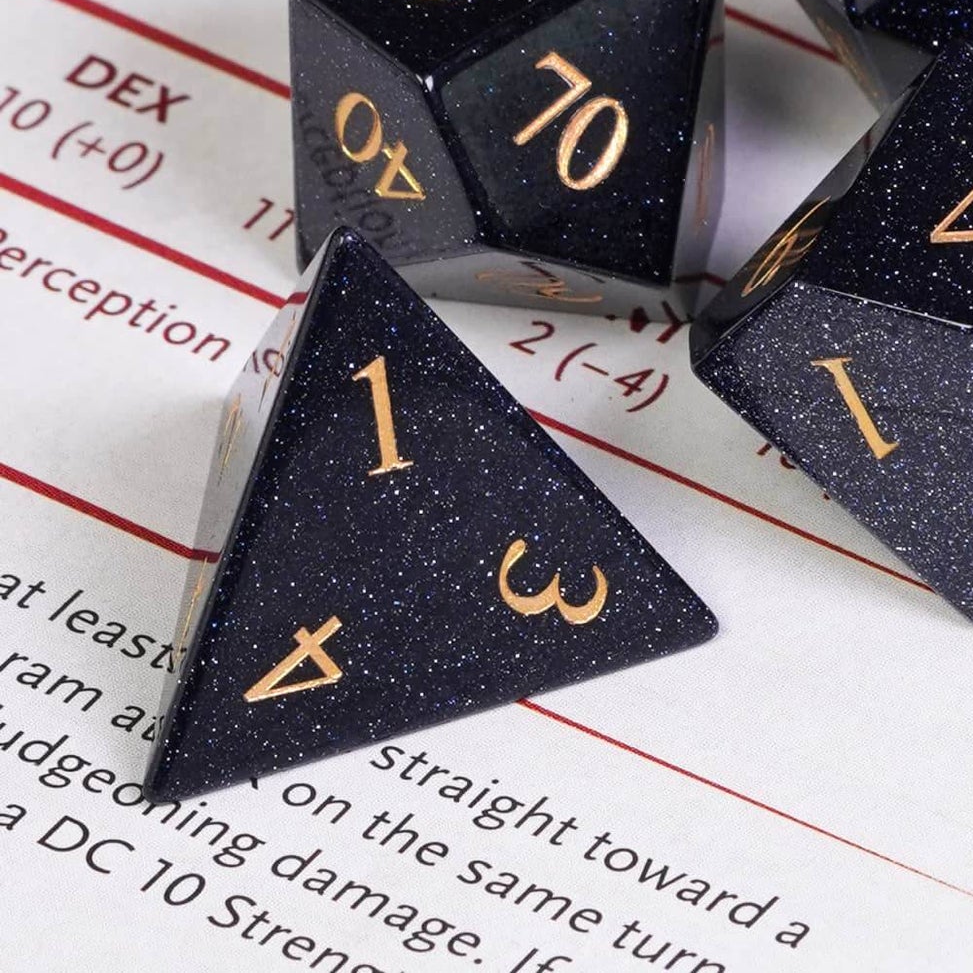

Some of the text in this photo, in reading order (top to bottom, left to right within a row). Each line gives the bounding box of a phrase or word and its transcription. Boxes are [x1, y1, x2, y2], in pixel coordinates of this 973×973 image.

[64, 53, 191, 125] DEX
[512, 51, 630, 192] 70
[50, 119, 165, 191] (+0)
[0, 227, 232, 364] erception
[509, 320, 556, 355] 2
[351, 354, 415, 477] 1
[809, 356, 899, 461] 1
[47, 589, 175, 670] least
[499, 538, 609, 626] 3
[242, 614, 344, 705] 4
[36, 814, 136, 875] DC
[139, 857, 207, 907] 10
[281, 782, 727, 973] on the same turn
[369, 744, 812, 949] straight toward a
[270, 848, 484, 966] damage.
